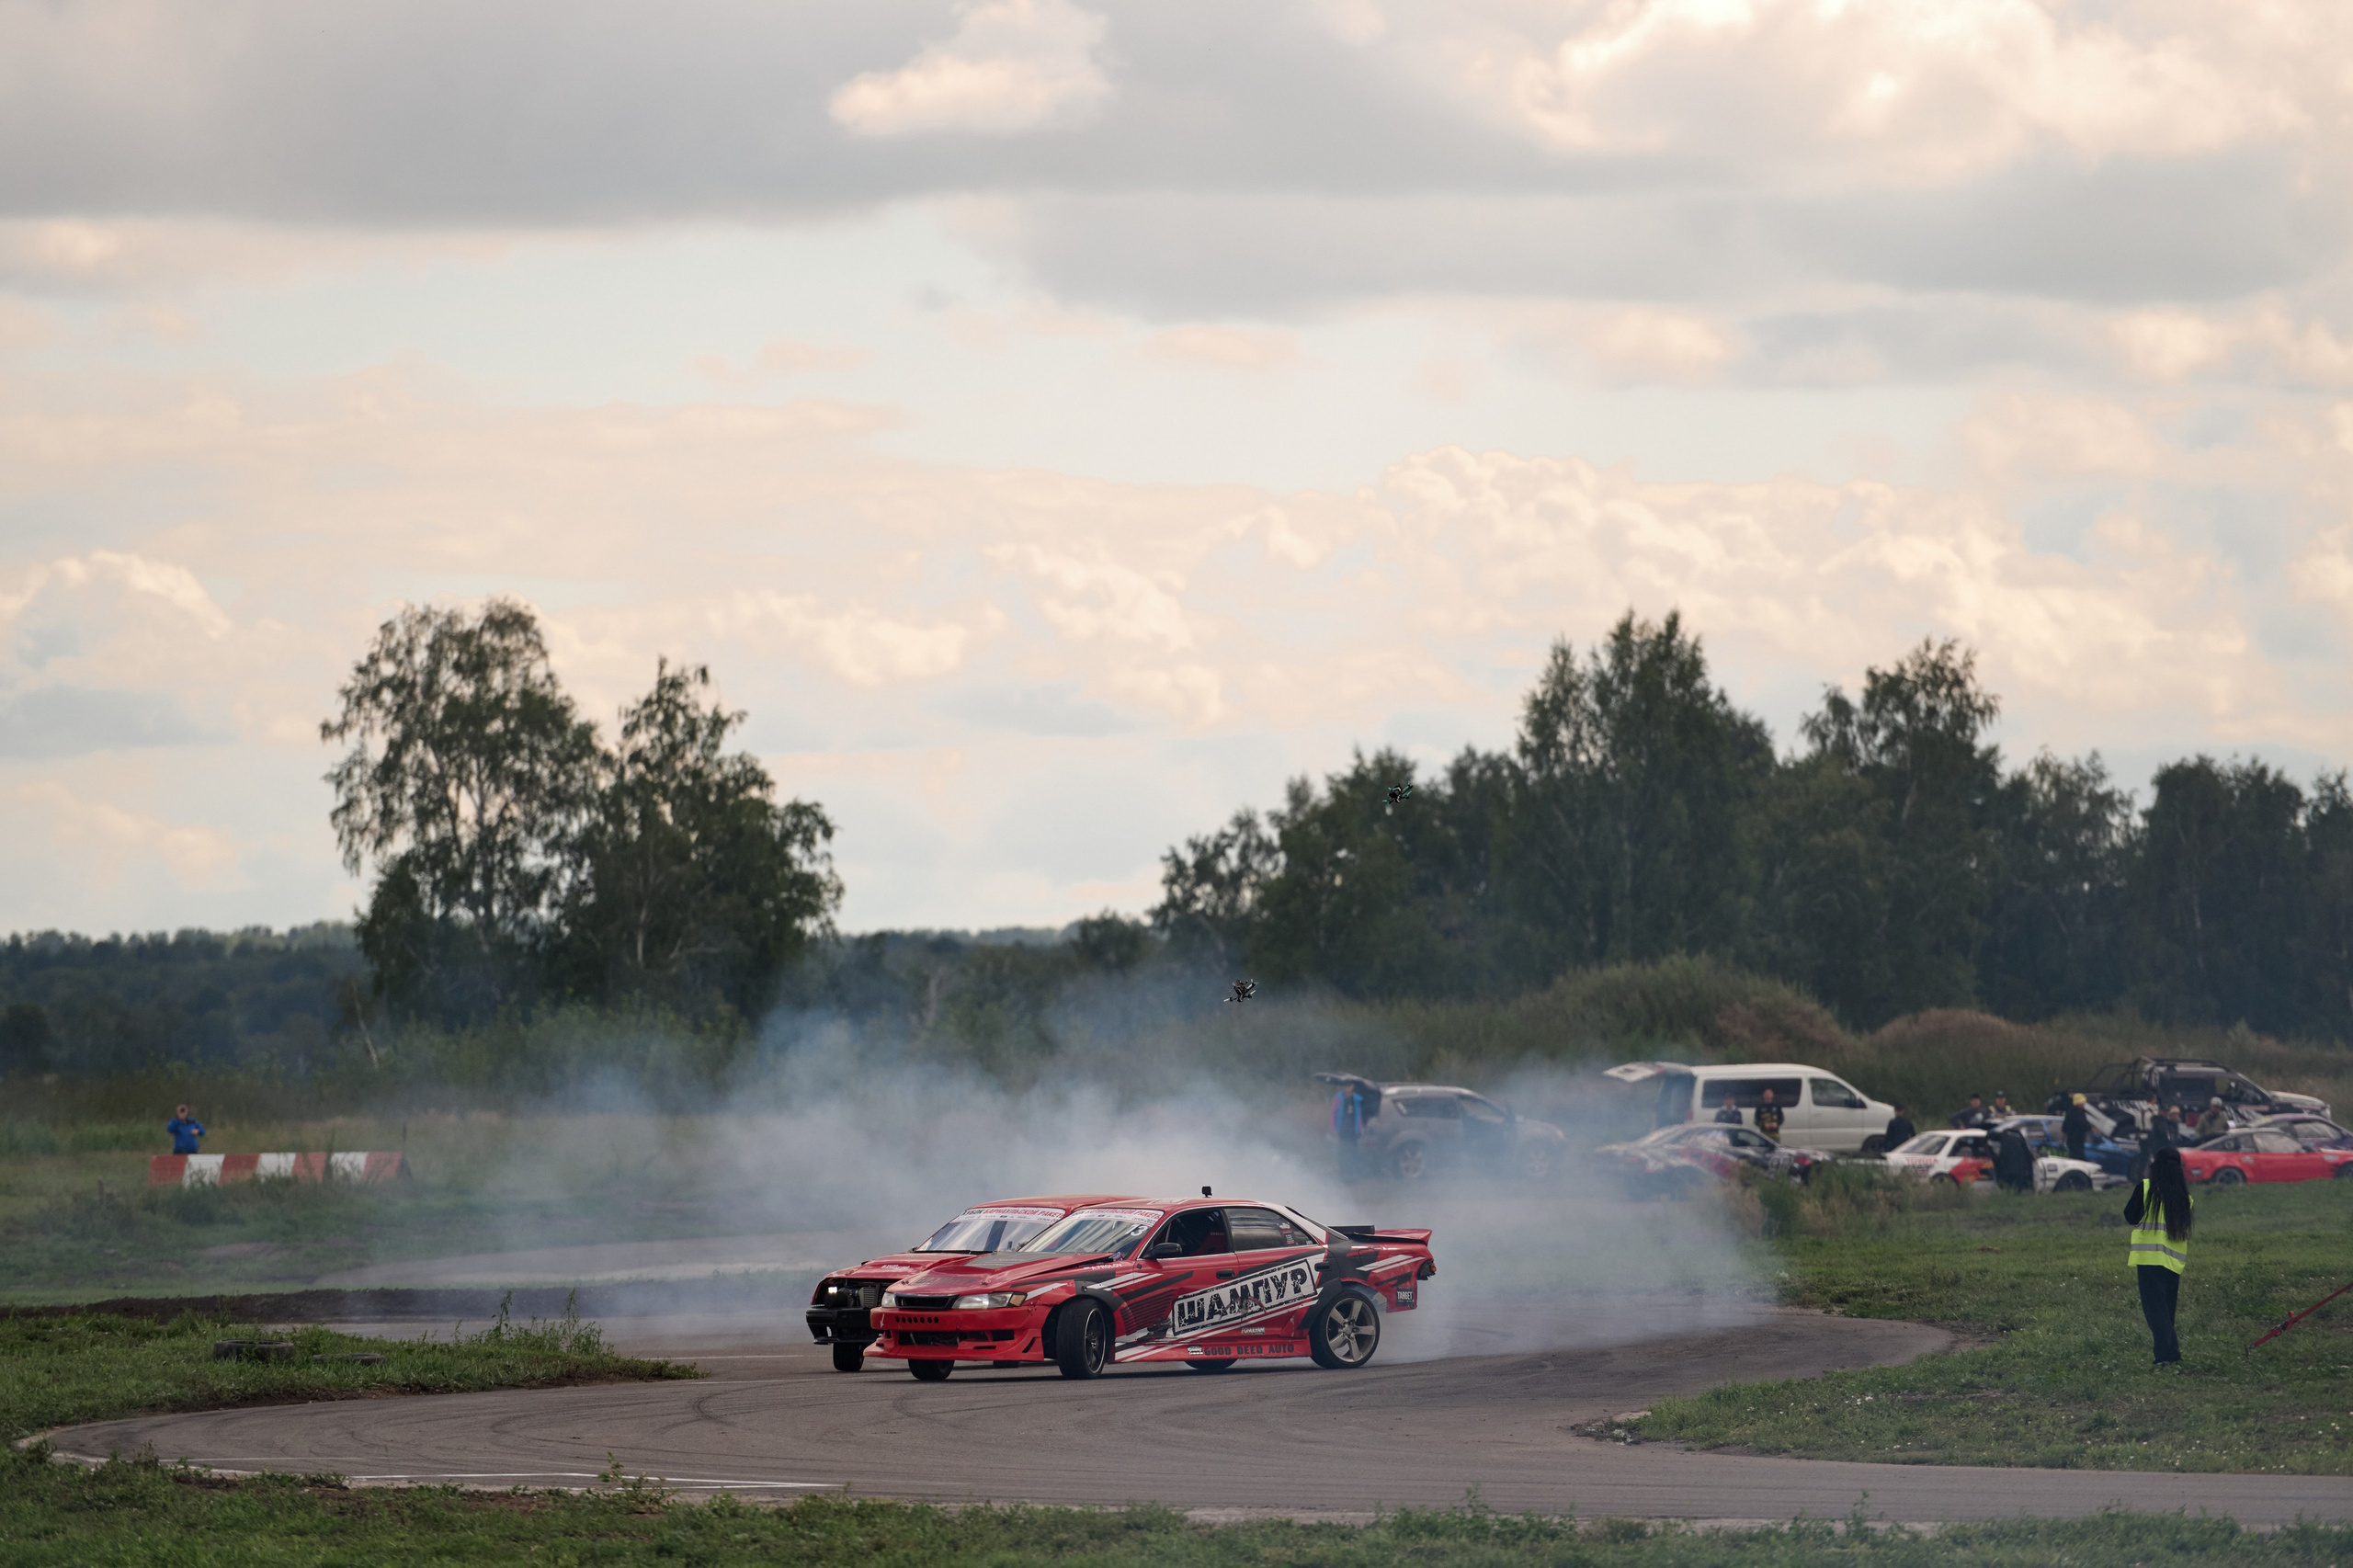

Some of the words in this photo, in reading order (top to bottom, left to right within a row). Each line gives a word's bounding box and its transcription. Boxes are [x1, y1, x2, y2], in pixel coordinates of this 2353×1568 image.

[1177, 1267, 1308, 1328] ШАМПУР
[1396, 1291, 1413, 1300] TARGET
[1204, 1346, 1232, 1356] GOOD
[1236, 1346, 1263, 1355] DEED
[1267, 1344, 1294, 1354] AUTO
